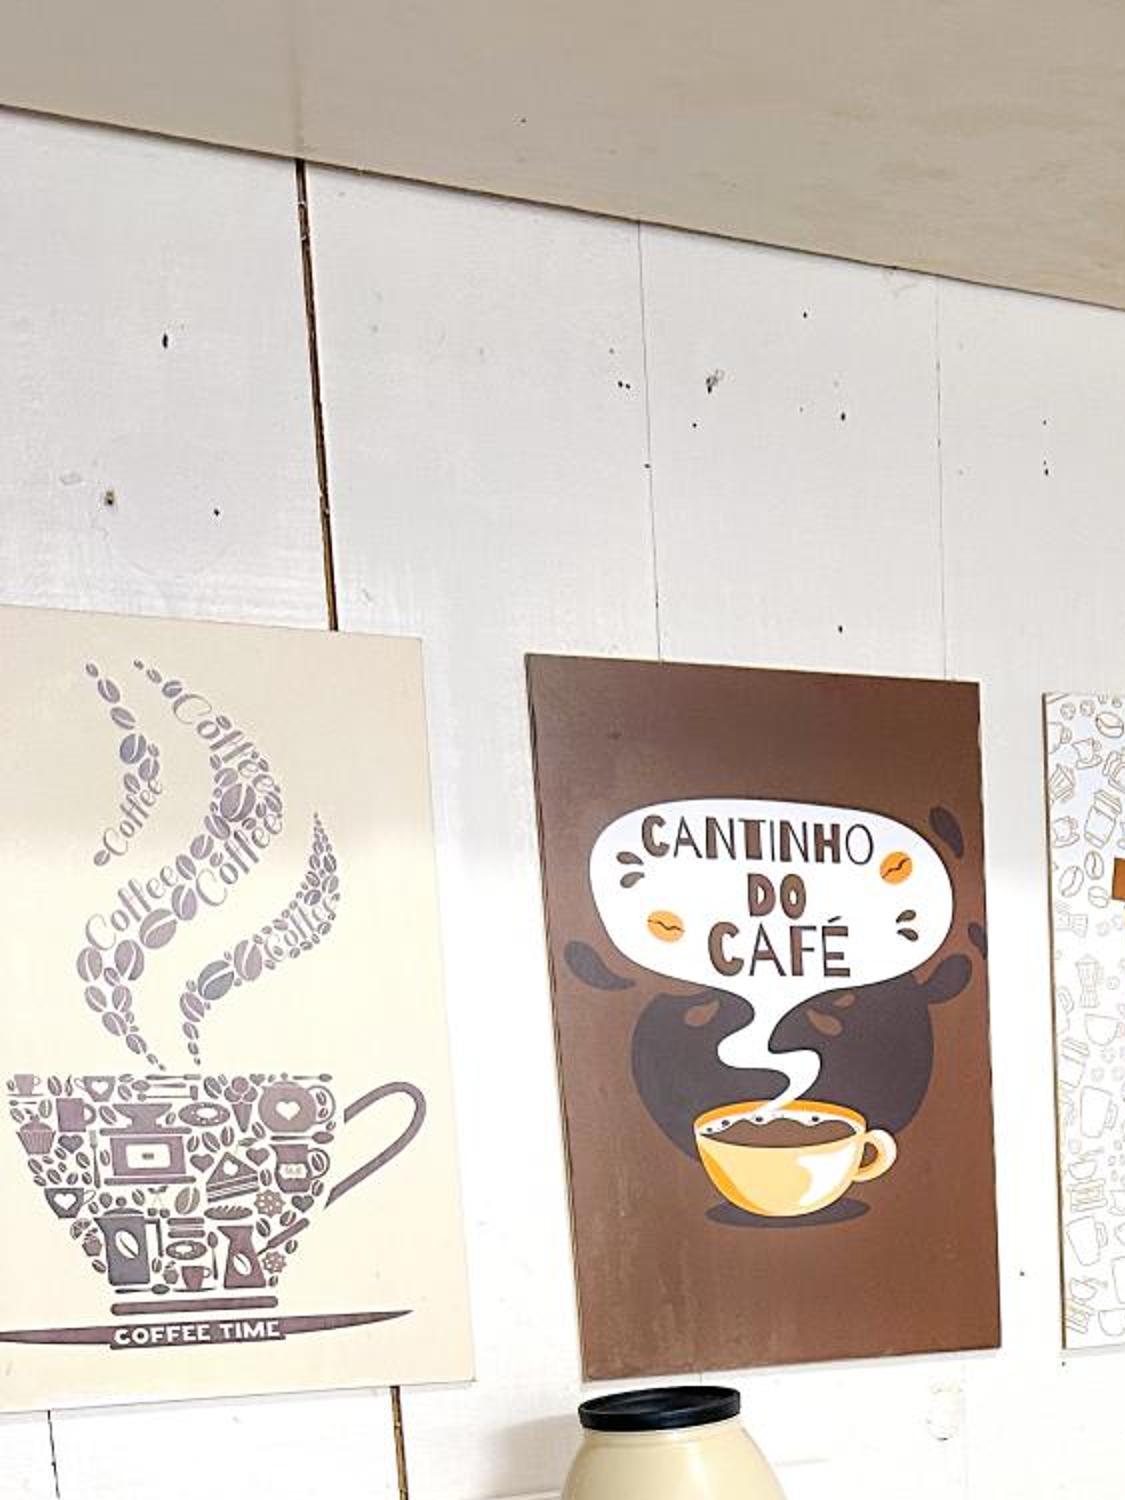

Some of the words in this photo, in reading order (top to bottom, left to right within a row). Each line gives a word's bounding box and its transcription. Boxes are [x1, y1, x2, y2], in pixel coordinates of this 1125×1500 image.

[172, 692, 281, 794] Coffee
[103, 778, 164, 857] Coffee
[641, 814, 874, 866] CANTINHO
[195, 813, 284, 907] Coffee
[85, 864, 179, 951] Coffee
[747, 872, 807, 920] DO
[707, 915, 851, 978] CAFÉ
[113, 1322, 211, 1346] COFFEE
[219, 1319, 281, 1339] TIME
